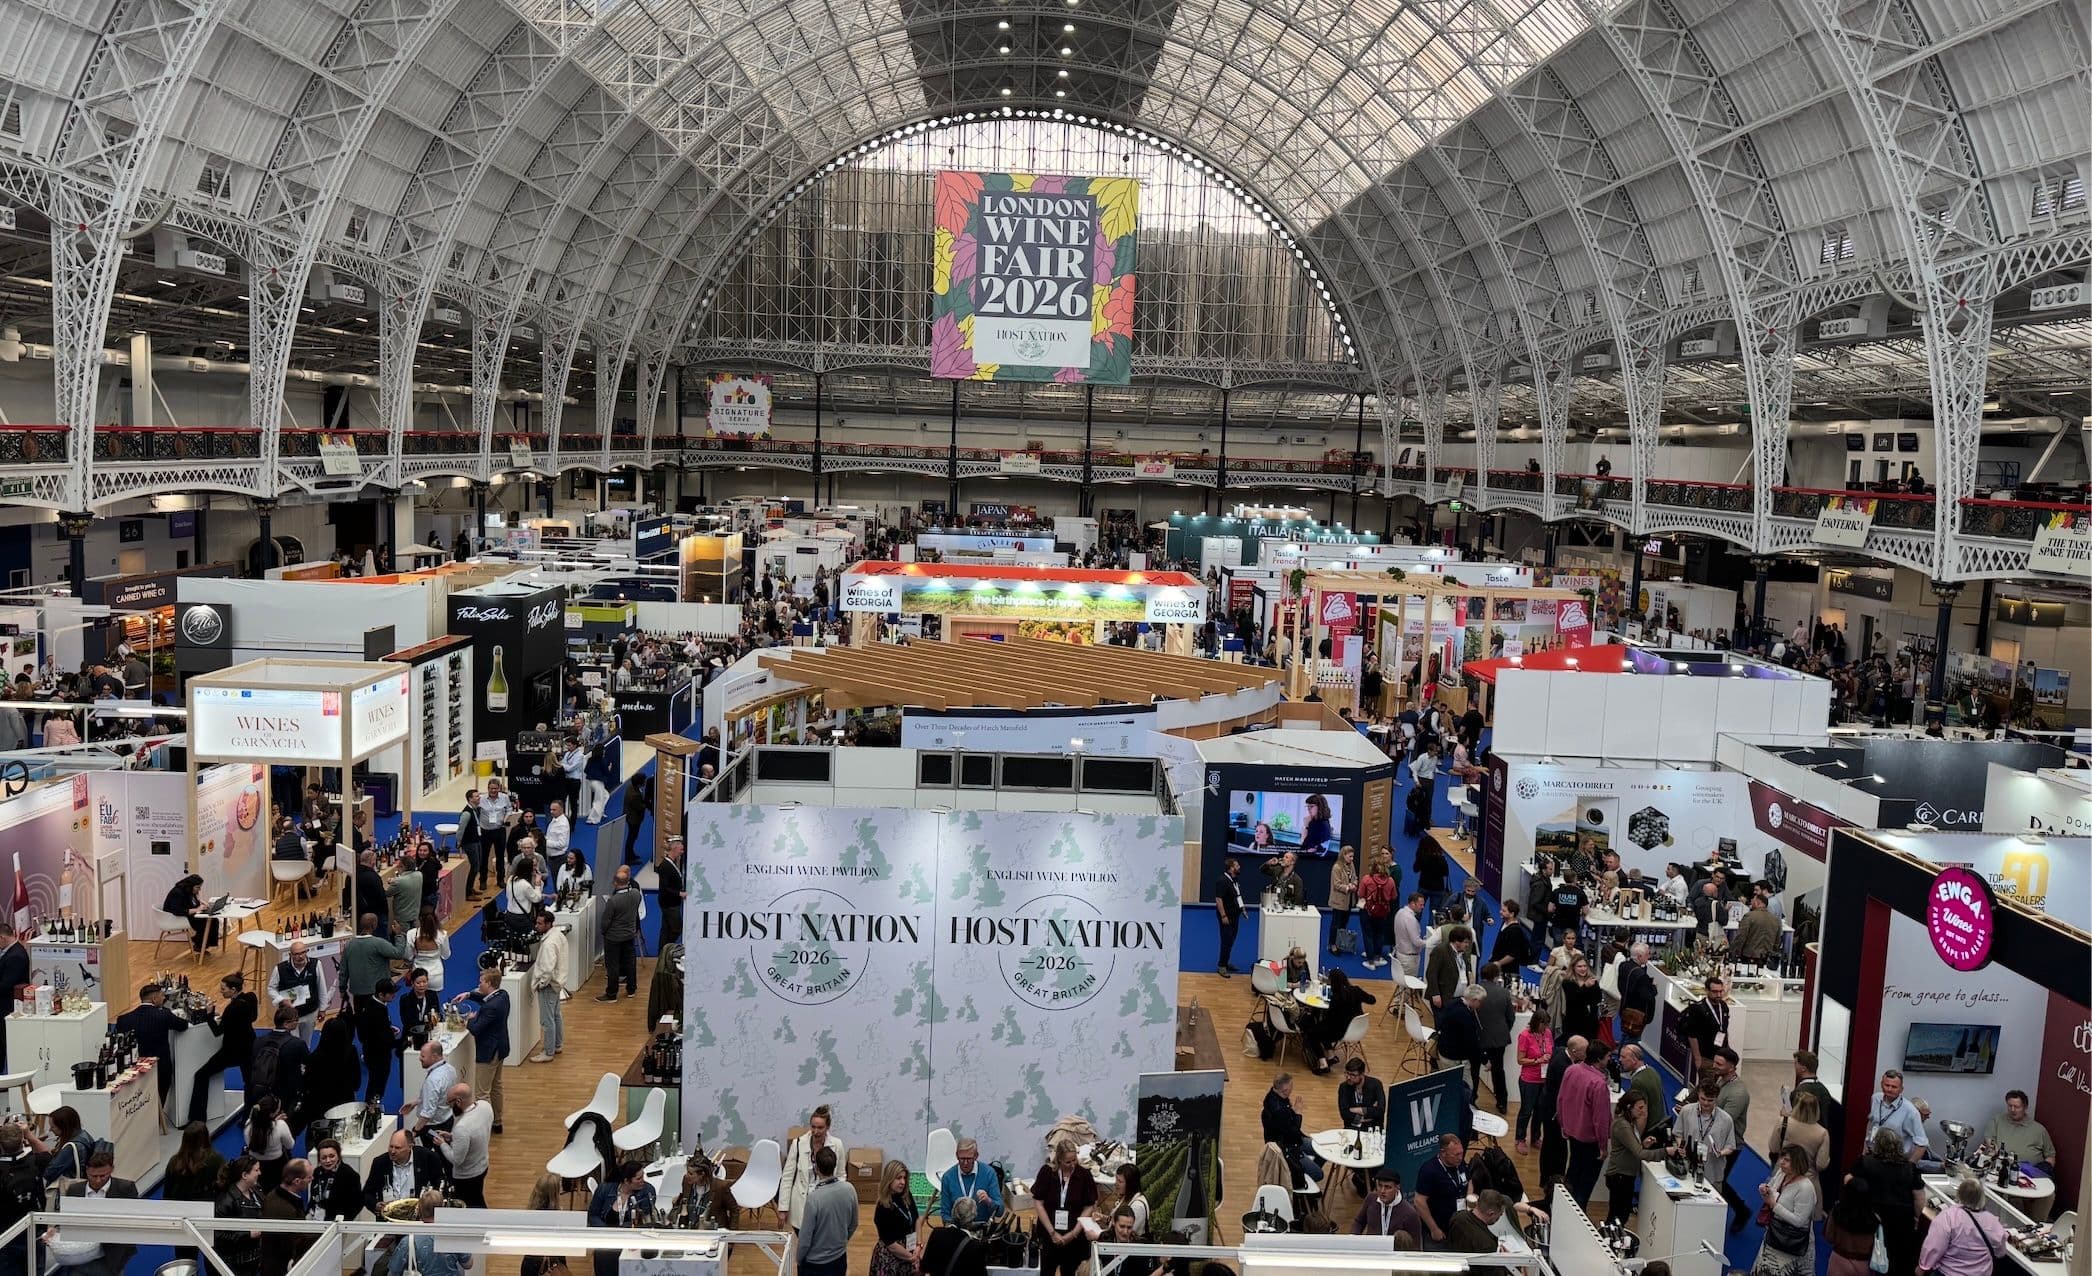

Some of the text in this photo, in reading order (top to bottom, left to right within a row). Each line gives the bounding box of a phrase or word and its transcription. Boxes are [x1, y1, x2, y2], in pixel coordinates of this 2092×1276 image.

[983, 196, 1090, 218] LONDON
[983, 216, 1091, 246] WINE
[981, 244, 1087, 279] FAIR
[979, 276, 1088, 317] 2026
[996, 329, 1068, 343] HOST NATION
[714, 408, 765, 417] SIGNATURE
[1877, 438, 1888, 448] Lift
[976, 504, 1008, 516] JAPAN
[1820, 516, 1864, 532] ESOTERICA
[1248, 525, 1289, 538] ITALIA
[2047, 537, 2066, 549] THE
[1273, 550, 1295, 558] Taste
[2037, 547, 2063, 559] SPACE
[1272, 558, 1298, 566] France
[1485, 573, 1510, 582] Taste
[1558, 576, 1595, 586] WINES
[116, 591, 141, 604] CANNED
[142, 588, 158, 599] WINE
[847, 588, 893, 597] wines of
[846, 597, 893, 608] GEORGIA
[1154, 599, 1200, 609] wines of
[1153, 608, 1199, 618] GEORGIA
[367, 703, 396, 725] WINES
[236, 715, 300, 732] WINES
[980, 723, 999, 731] Hatch
[1000, 724, 1028, 732] Mansfield
[231, 735, 306, 750] GARNACHA
[1543, 780, 1615, 790] MARCATO DIRECT
[99, 804, 112, 816] EU
[100, 815, 113, 825] FAB
[1783, 810, 1827, 837] MARCATO DIRECT
[745, 863, 880, 878] ENGLISH WINE PAVILION
[986, 869, 1118, 883] ENGLISH WINE PAVILION
[1988, 873, 2005, 883] TOP
[1938, 881, 1982, 920] EWGA
[700, 910, 921, 944] HOST NATION
[1943, 907, 1974, 933] Wines
[949, 915, 1166, 950] HOST NATION
[1932, 906, 1986, 961] FROM GRAPE TO GLASS
[789, 950, 830, 965] 2026
[1035, 955, 1076, 971] 2026
[766, 966, 851, 995] GREAT BRITAIN
[1013, 971, 1097, 1000] GREAT BRITAIN
[1884, 985, 2009, 1008] From grape to glass...
[1155, 1102, 1175, 1111] THE
[1406, 1135, 1440, 1152] WILLIAMS
